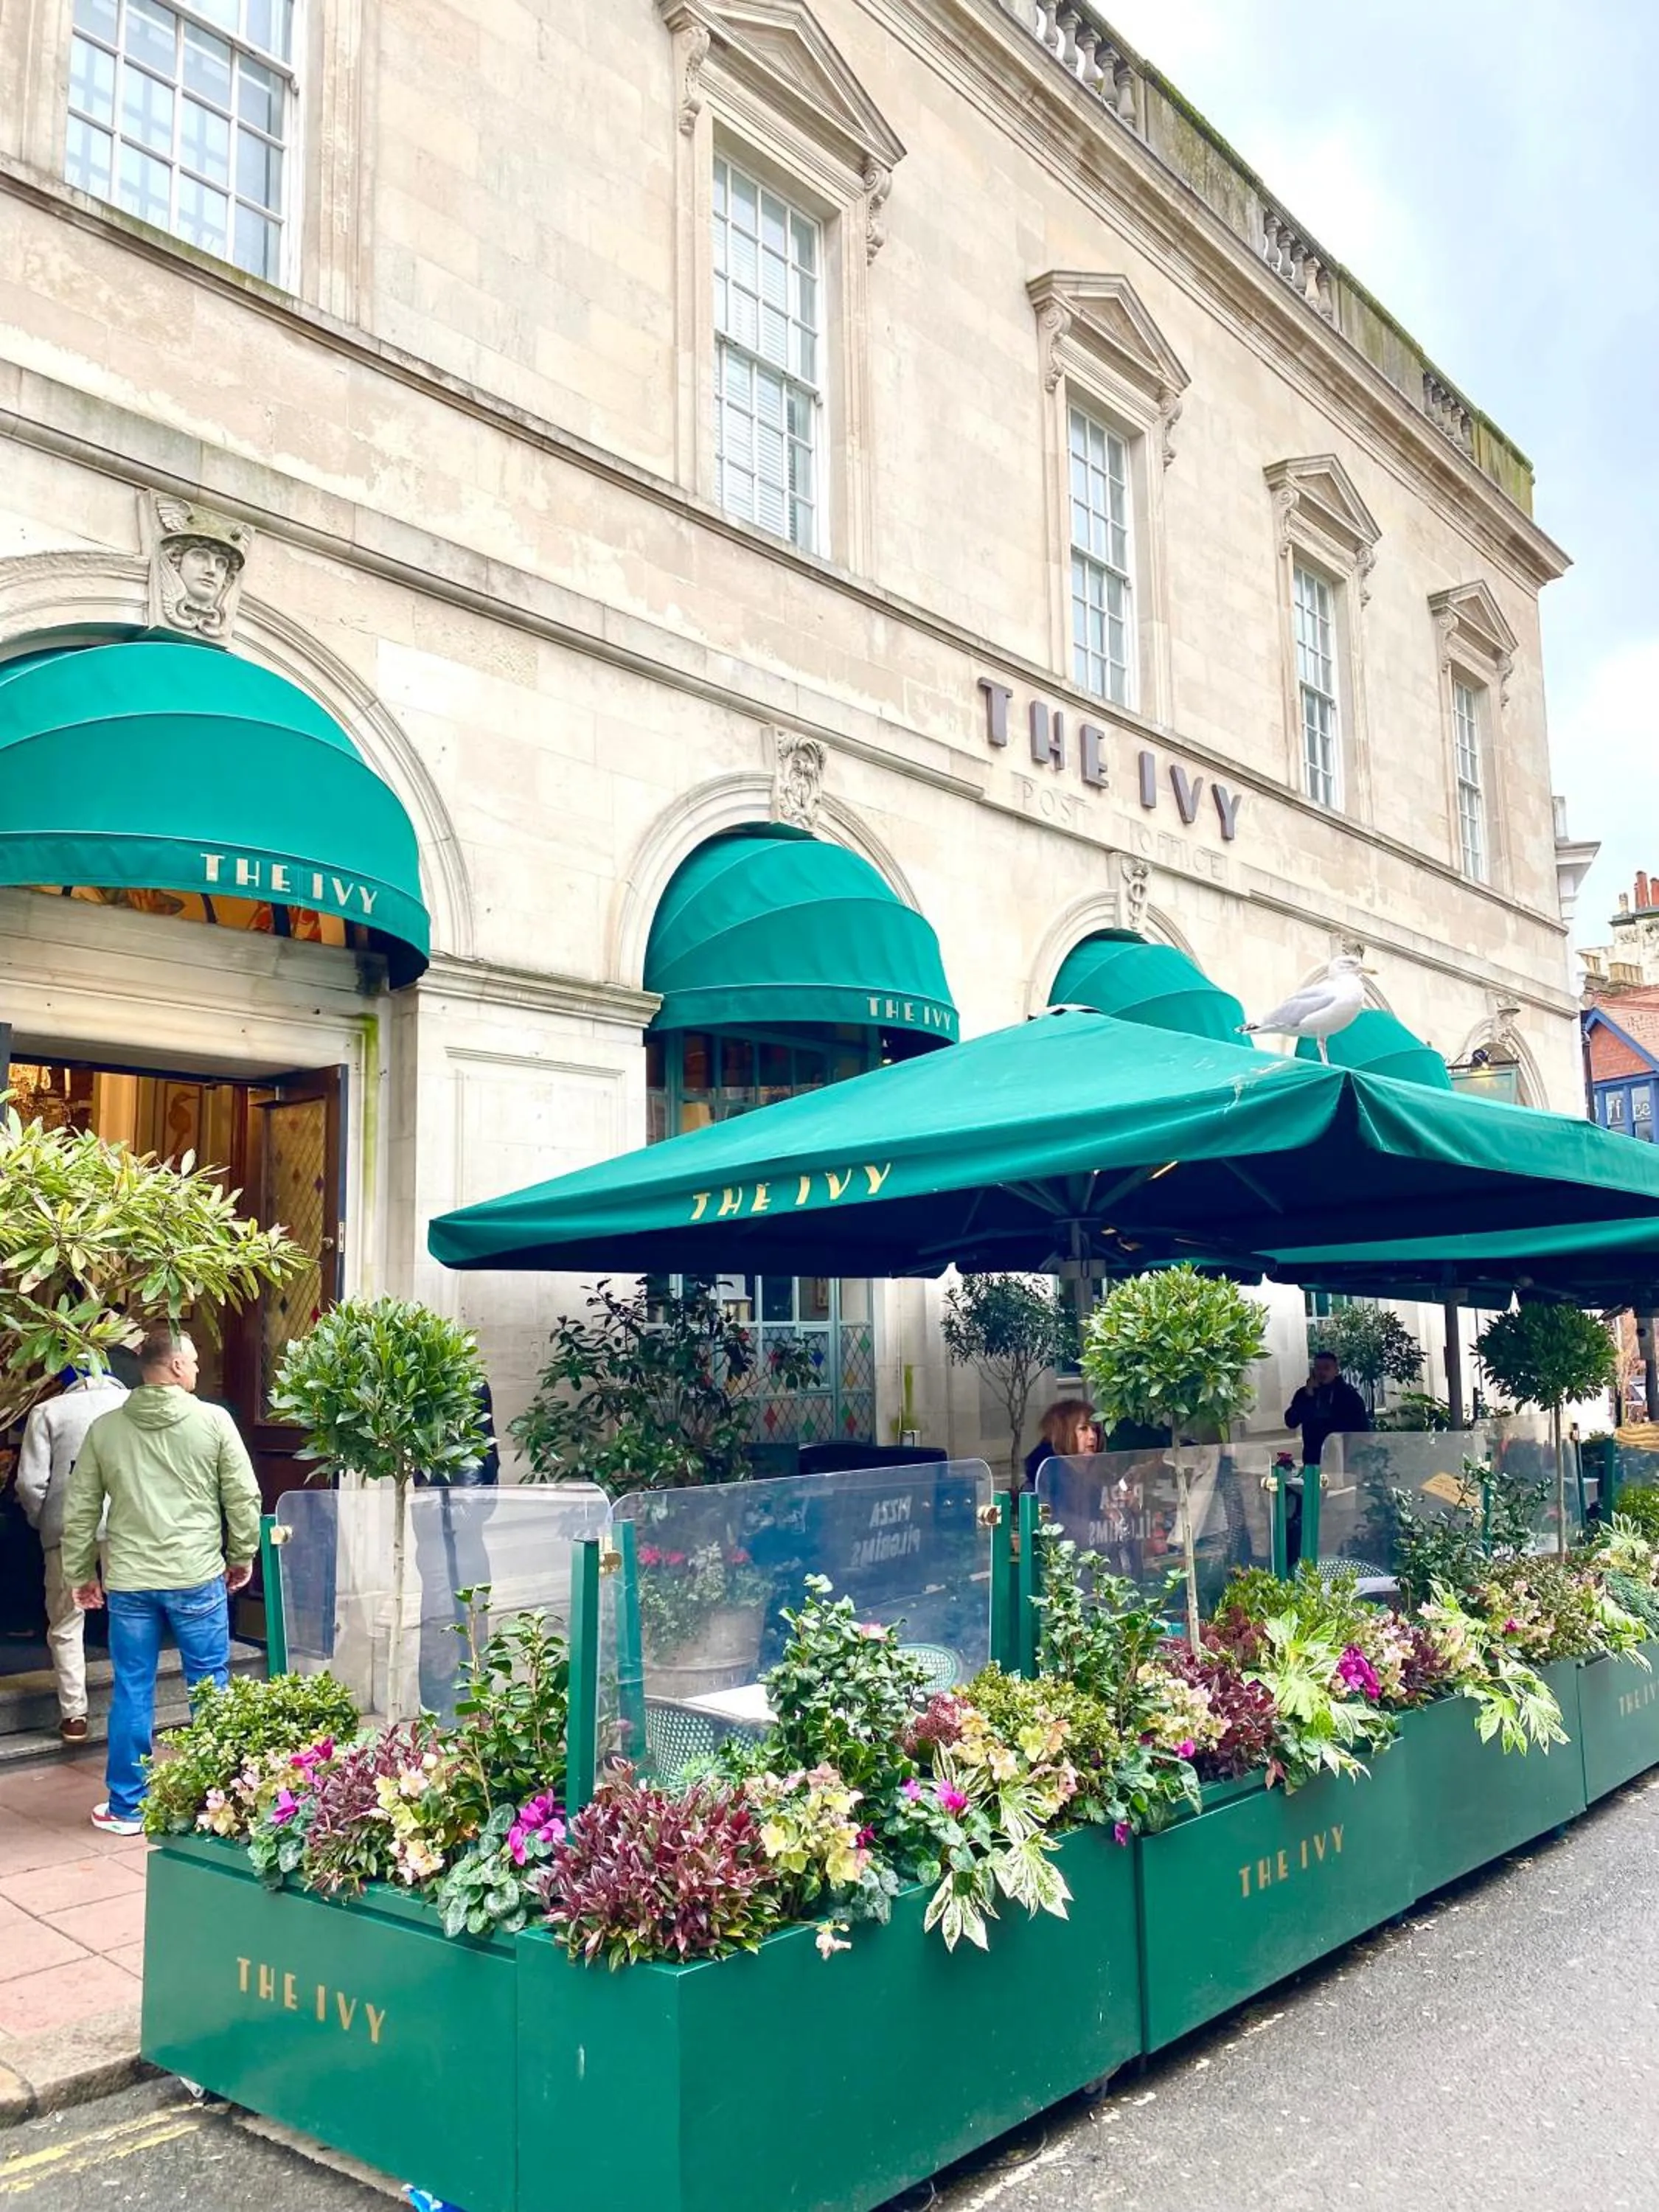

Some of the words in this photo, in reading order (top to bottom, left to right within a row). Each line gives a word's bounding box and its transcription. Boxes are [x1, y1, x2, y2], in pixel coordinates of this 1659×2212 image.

[978, 676, 1109, 790] THE
[1138, 751, 1242, 841] IVY
[1021, 779, 1085, 829] POST
[200, 852, 291, 893] THE
[312, 872, 378, 914] IVY
[866, 996, 914, 1021] THE
[924, 1005, 950, 1030] IVY
[690, 1183, 771, 1220] THE
[796, 1163, 891, 1205] IVY
[1618, 1688, 1641, 1717] THE
[1644, 1680, 1659, 1705] IV
[1239, 1849, 1288, 1898] THE
[1301, 1823, 1344, 1869] IVY
[237, 1956, 297, 2011] THE
[316, 1984, 386, 2045] IVY
